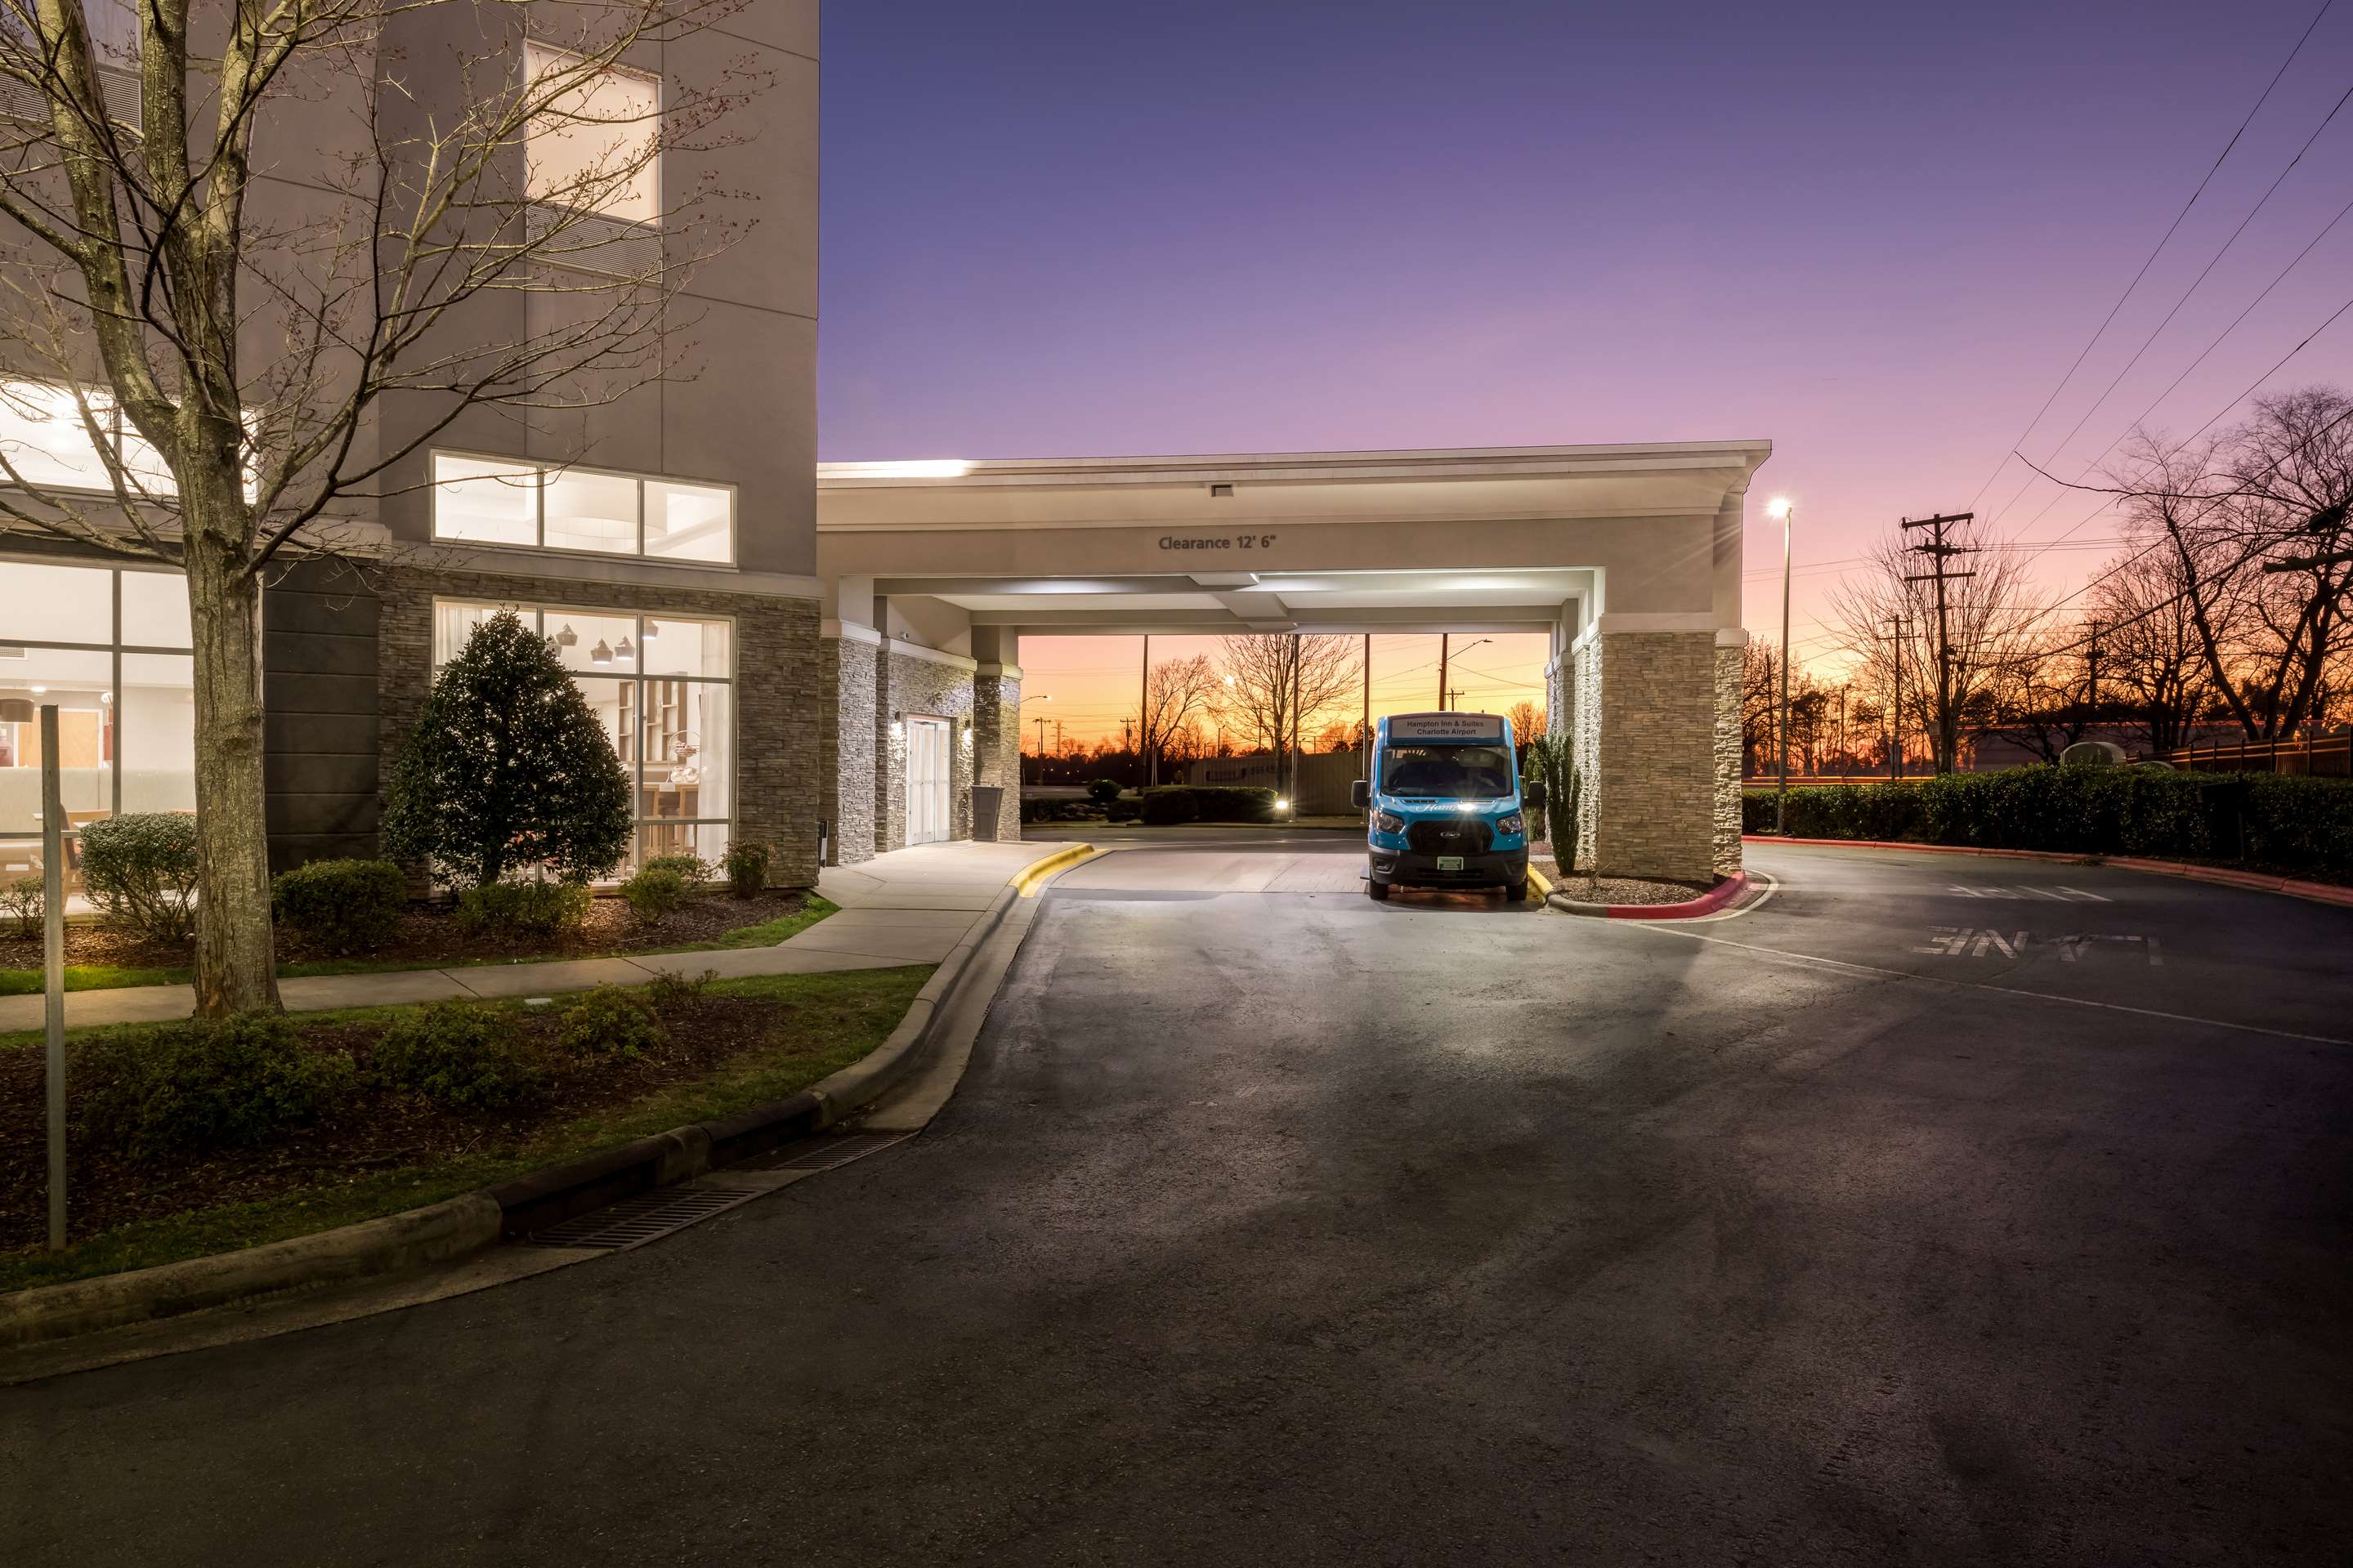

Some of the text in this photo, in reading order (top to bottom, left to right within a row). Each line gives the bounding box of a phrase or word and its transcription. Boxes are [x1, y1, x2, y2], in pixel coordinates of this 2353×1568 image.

[1158, 534, 1277, 550] Clearance 12' 6"
[1407, 720, 1439, 729] Hampton
[1451, 728, 1476, 736] Airport
